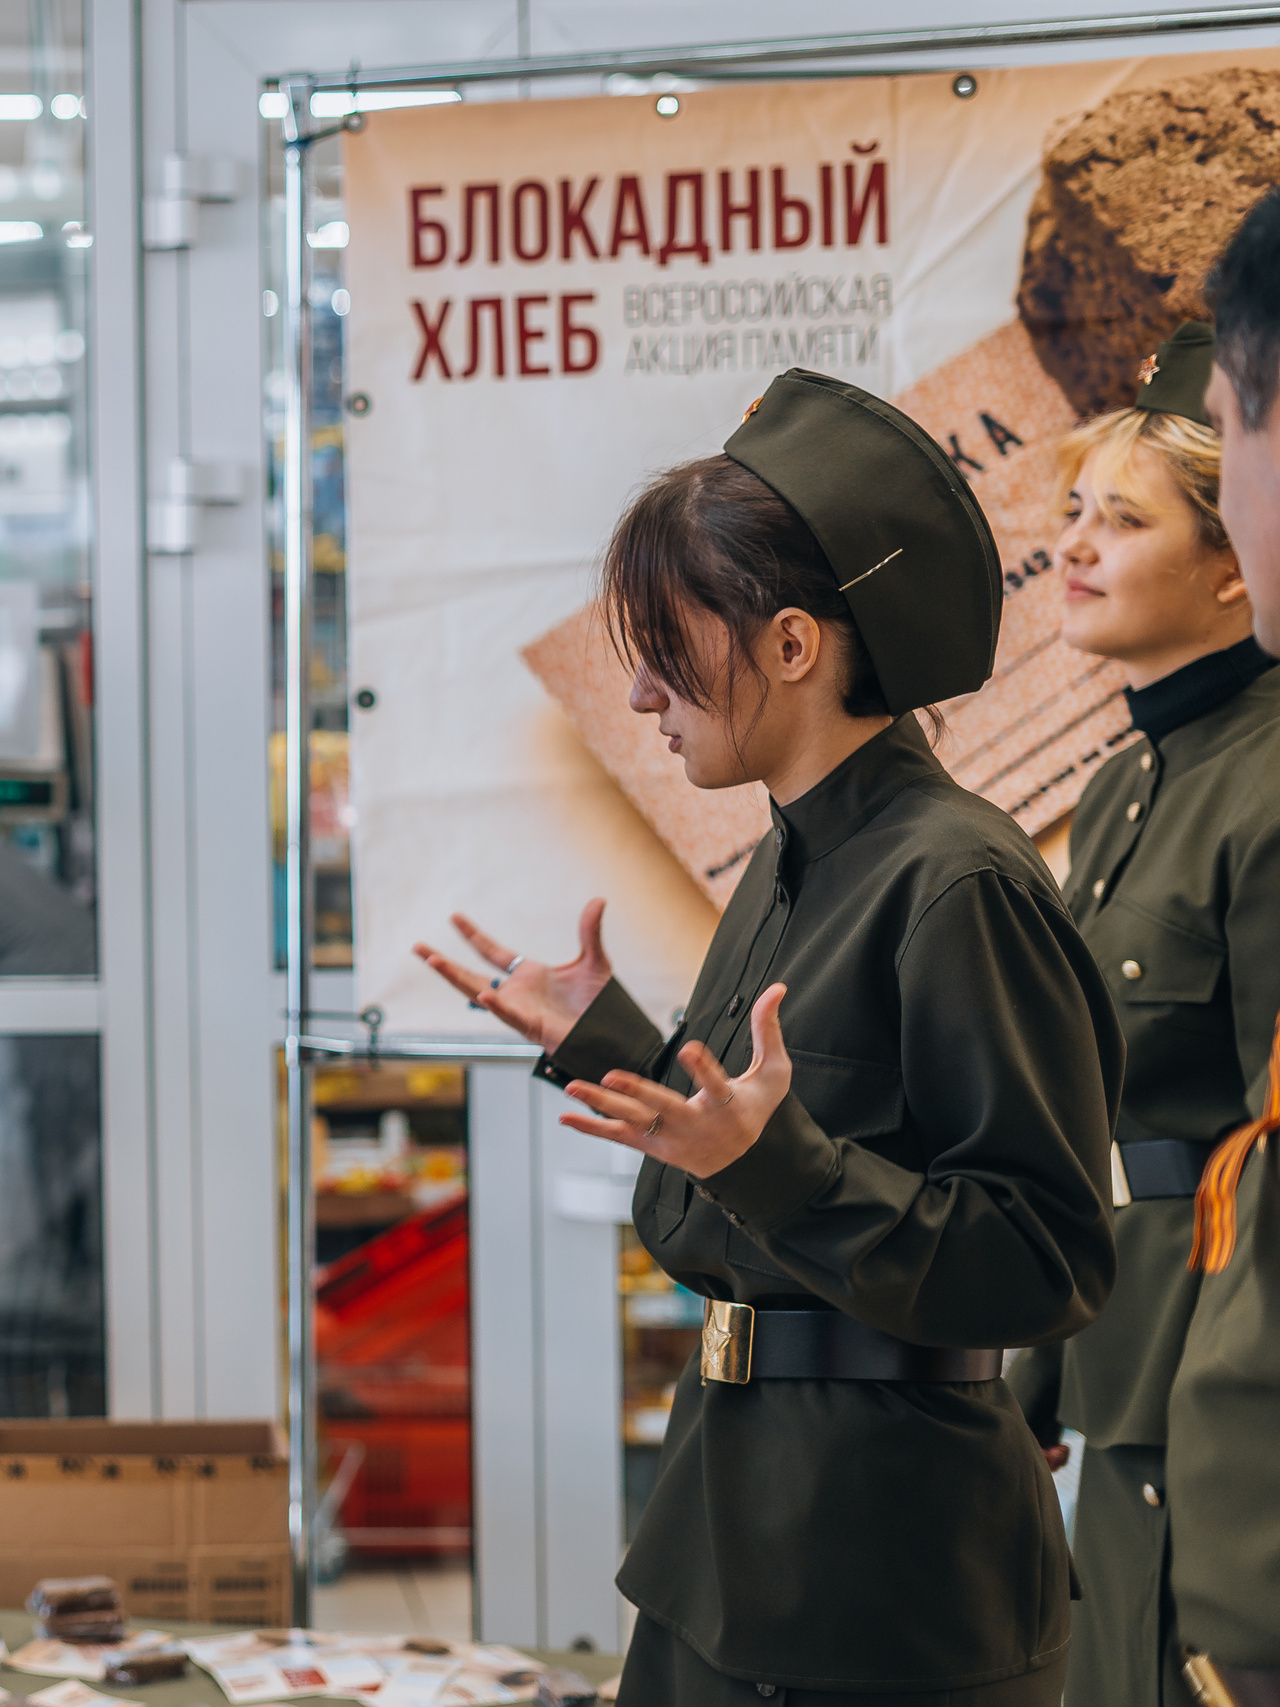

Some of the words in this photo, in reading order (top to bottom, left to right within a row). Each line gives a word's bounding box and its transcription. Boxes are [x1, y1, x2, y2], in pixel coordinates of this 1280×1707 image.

[409, 140, 889, 269] БЛОКАДНЫЙ
[409, 291, 602, 384] ХЛЕБ
[623, 271, 894, 329] ВСЕРОССИЙСКАЯ
[623, 328, 738, 377] АКЦИЯ
[741, 322, 882, 372] ПАМЯТИ
